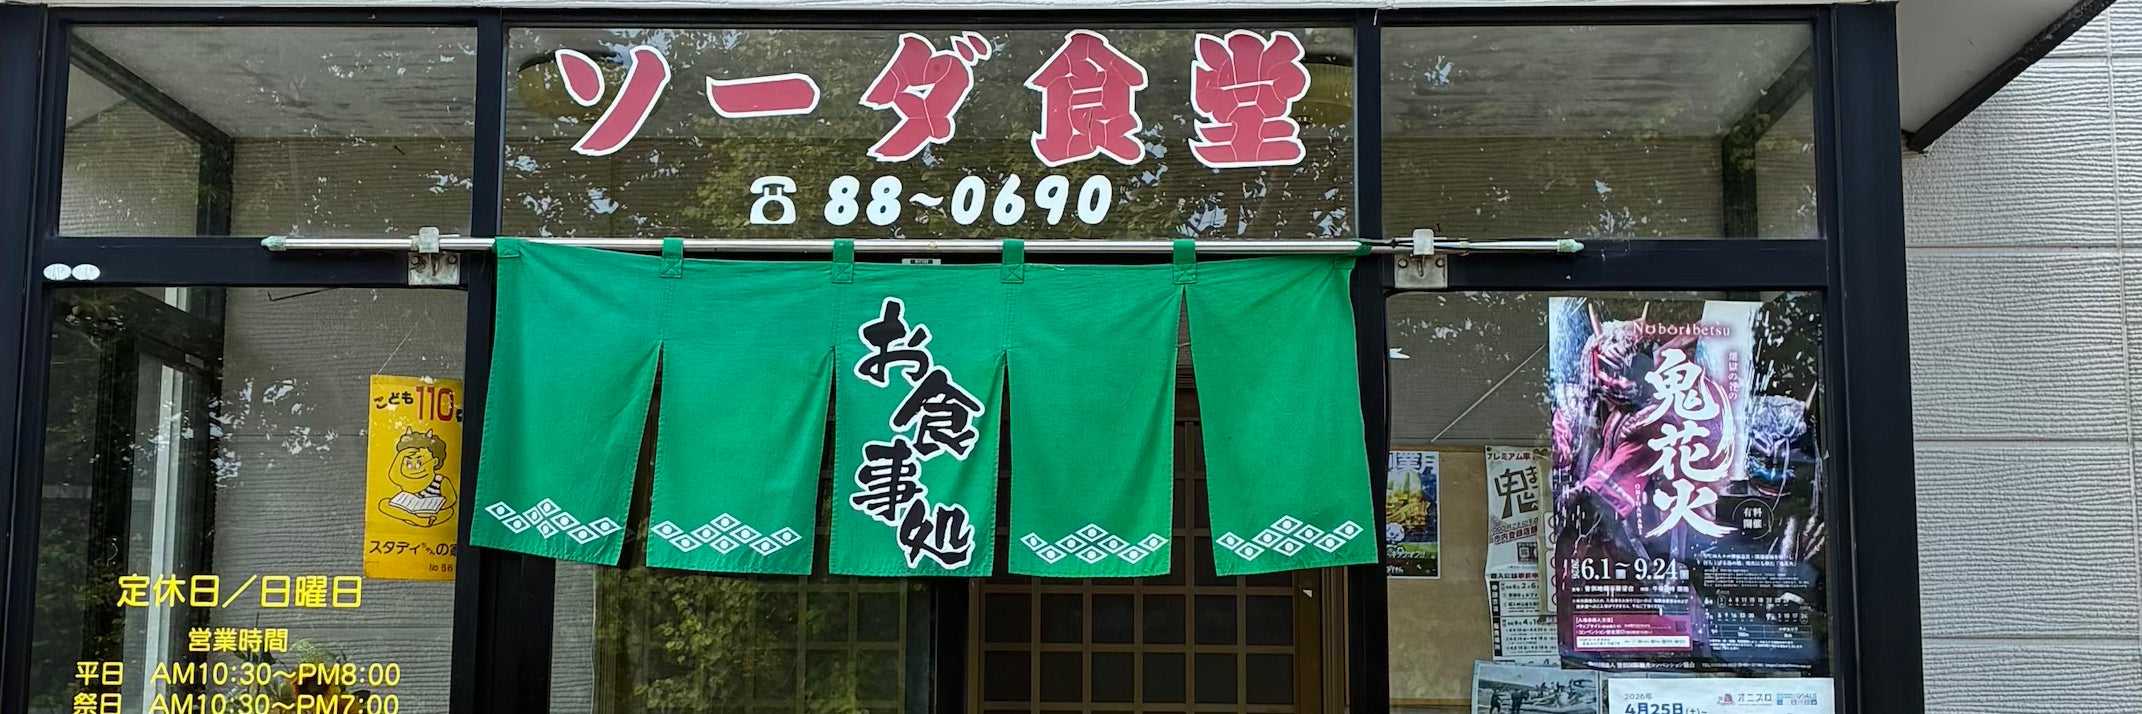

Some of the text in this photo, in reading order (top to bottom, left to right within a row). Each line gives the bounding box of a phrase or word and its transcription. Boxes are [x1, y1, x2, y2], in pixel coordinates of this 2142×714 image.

[553, 28, 1313, 168] ソーダ食堂
[1633, 321, 1731, 337] Noboribetsu
[373, 385, 463, 423] こども110
[848, 297, 983, 570] お食事処
[1635, 347, 1739, 539] 鬼花火
[188, 627, 288, 653] 営業時間
[75, 661, 124, 686] 平日
[72, 692, 122, 714] 祭日
